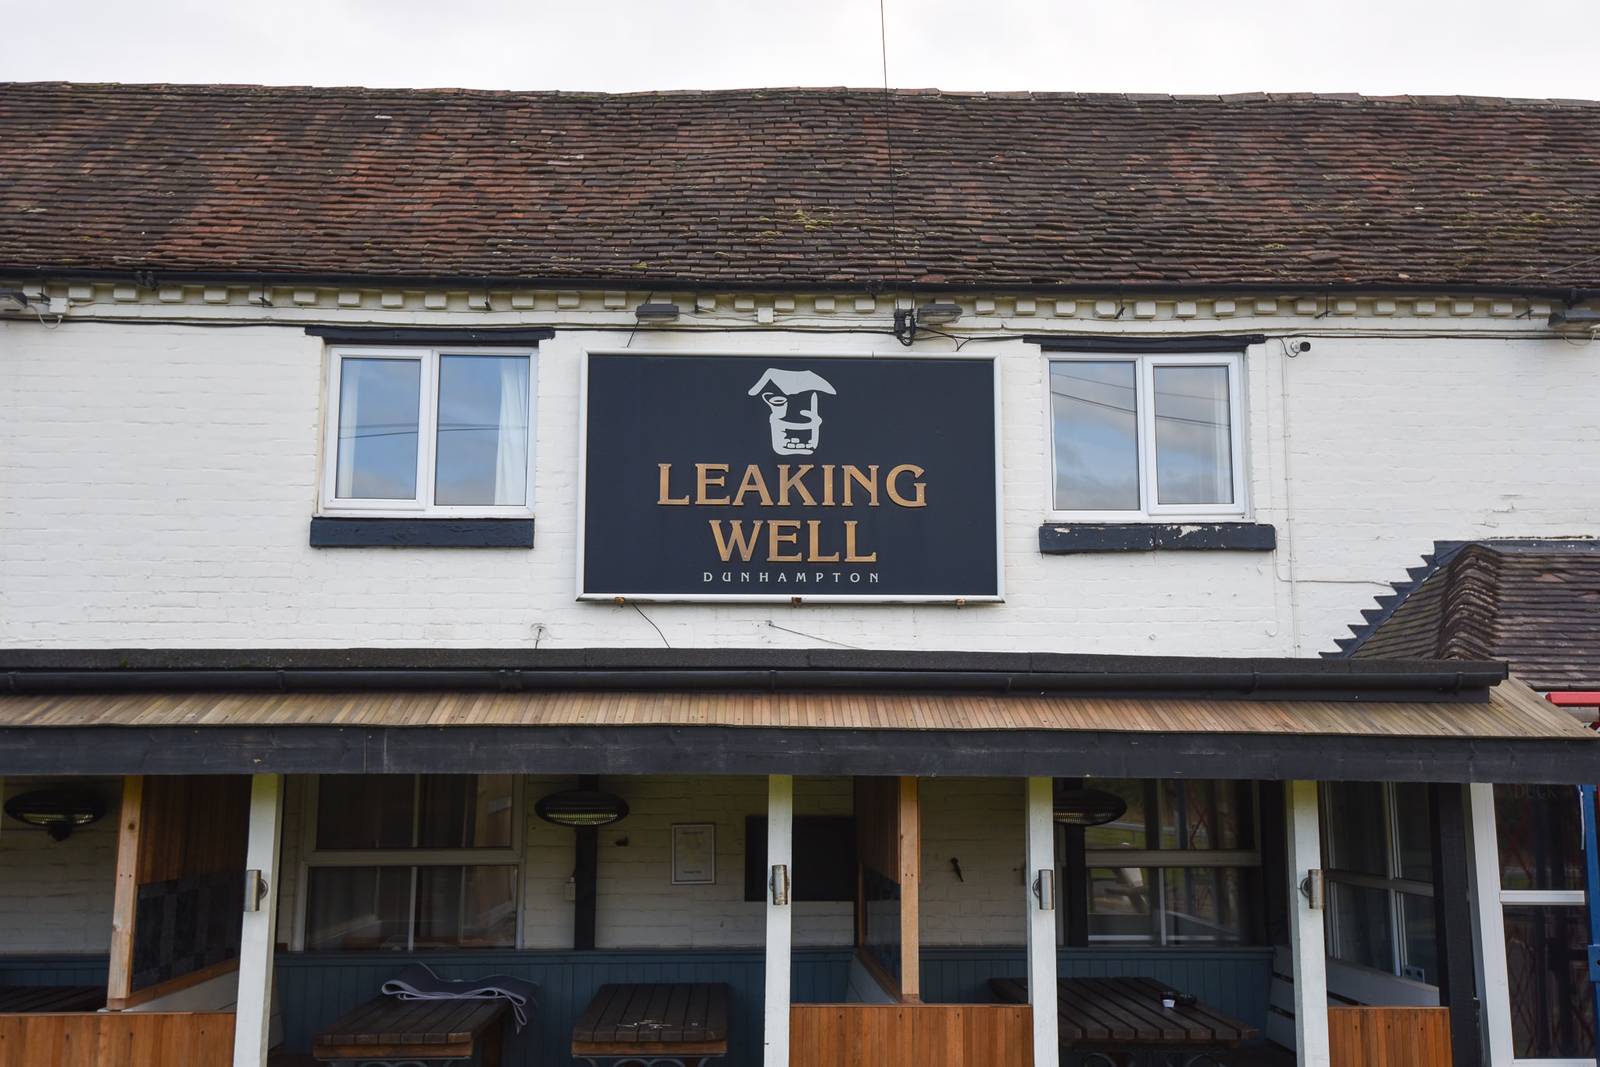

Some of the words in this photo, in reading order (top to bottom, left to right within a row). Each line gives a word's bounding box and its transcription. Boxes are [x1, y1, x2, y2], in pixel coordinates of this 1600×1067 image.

[657, 463, 927, 507] LEAKING
[708, 519, 877, 563] WELL
[703, 571, 880, 583] DUNHAMPTON
